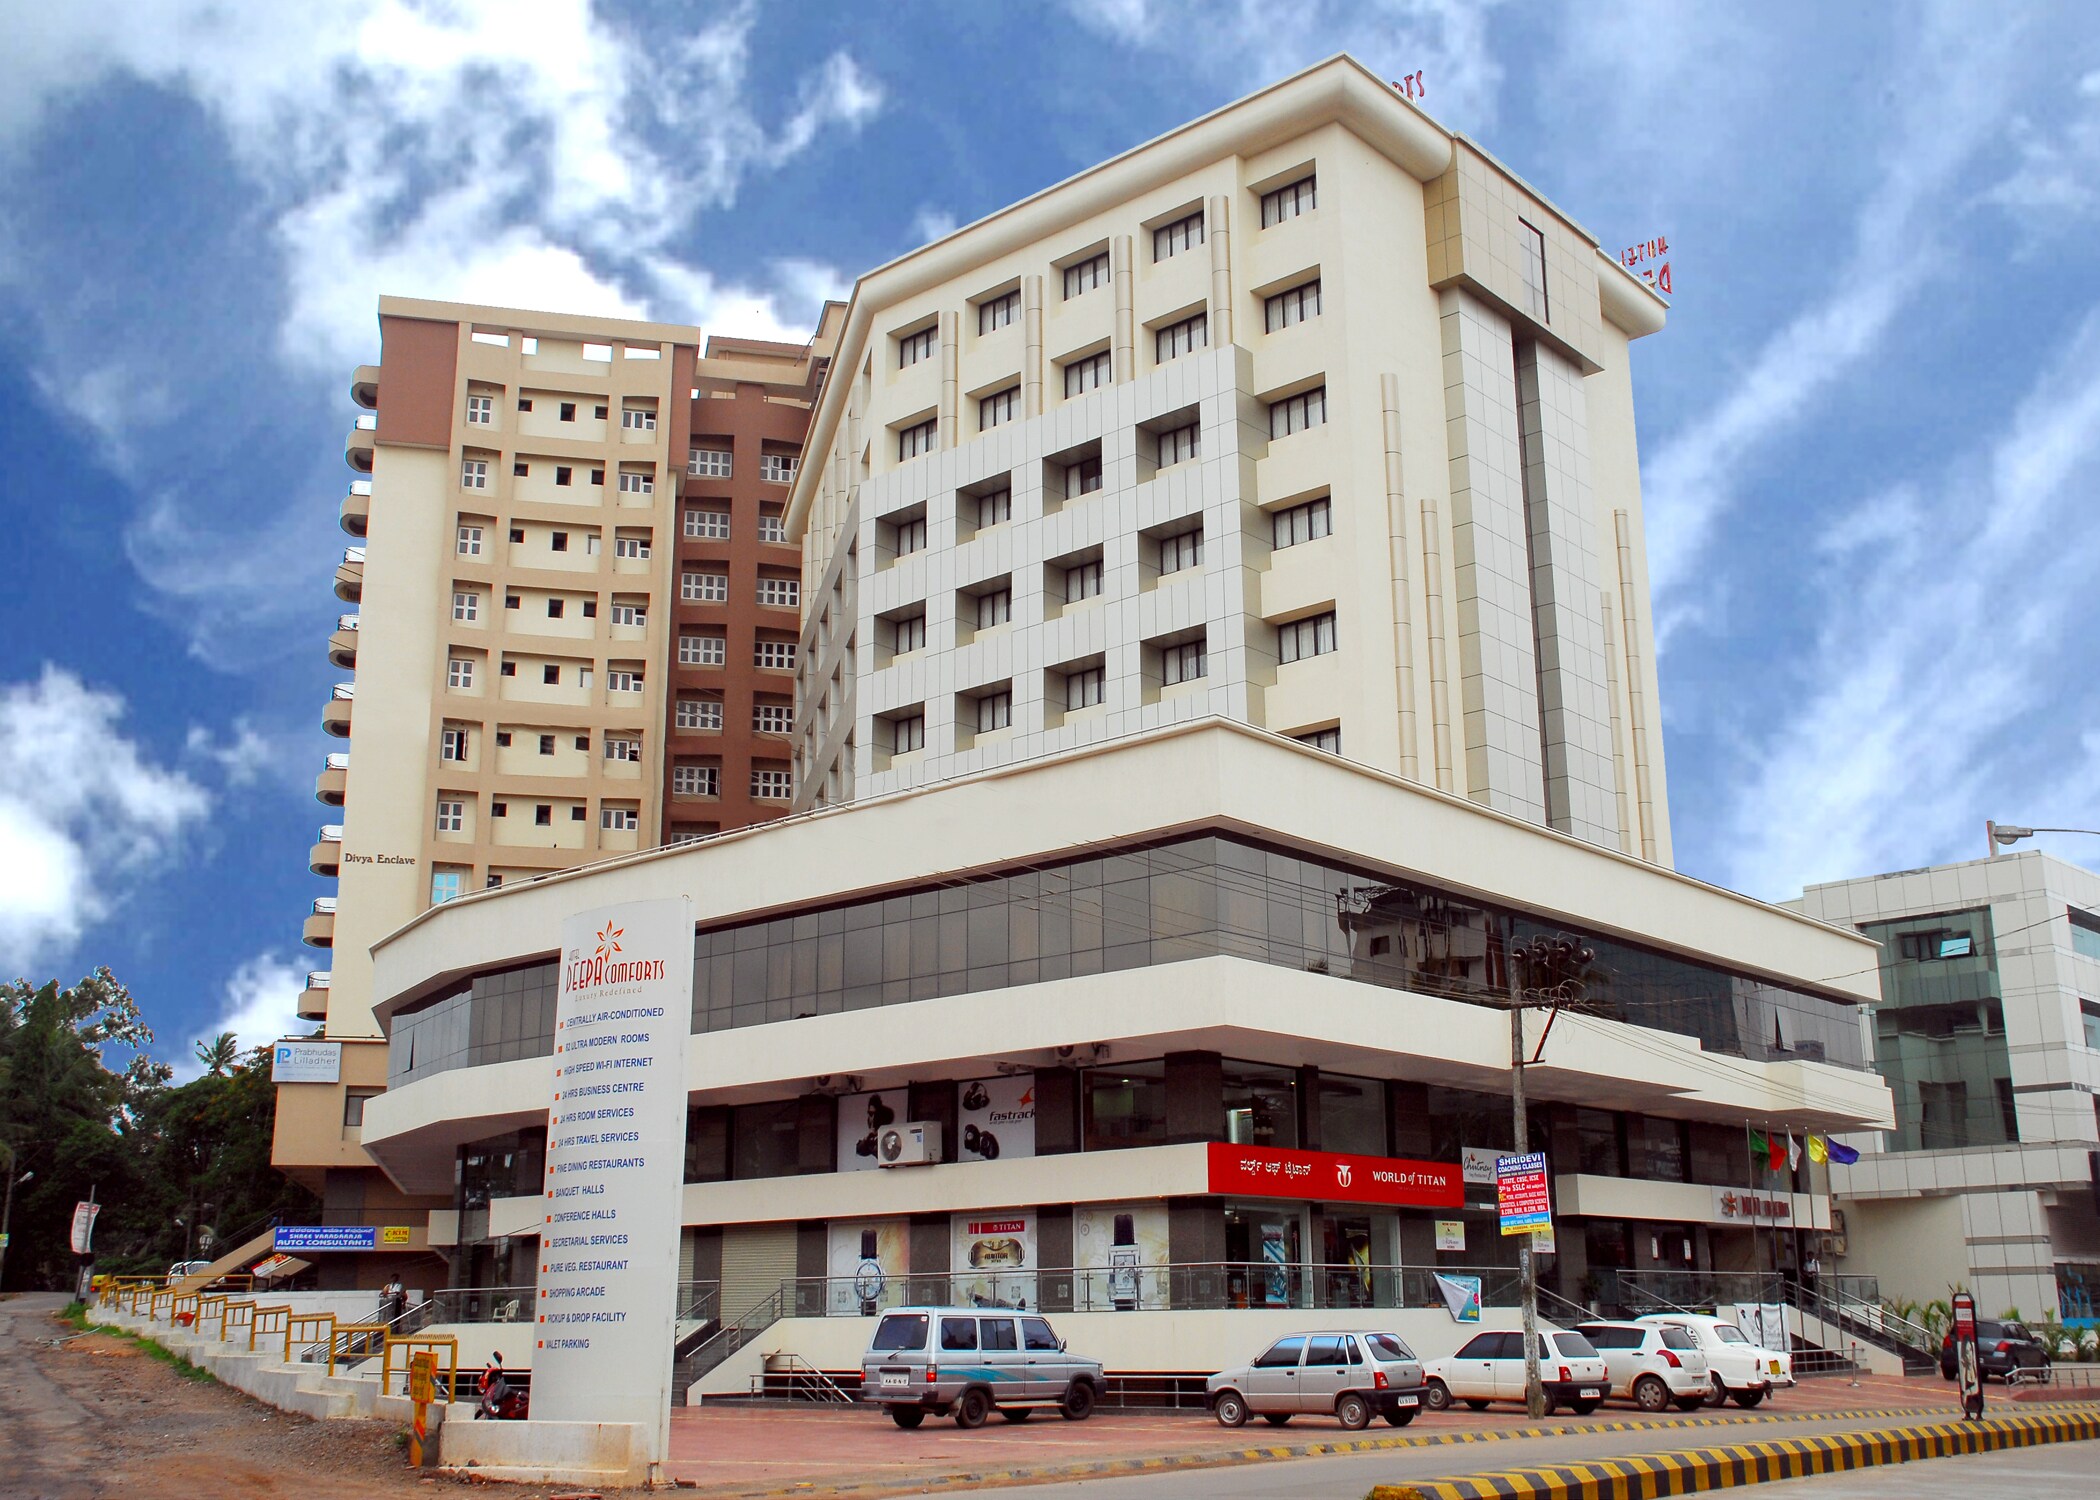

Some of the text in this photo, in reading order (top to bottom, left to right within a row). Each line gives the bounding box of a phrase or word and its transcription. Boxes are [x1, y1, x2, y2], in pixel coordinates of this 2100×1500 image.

[345, 852, 416, 865] Divya Enclave
[565, 956, 665, 995] DEEPA COMFORTS
[575, 986, 642, 1003] Luxury Redefined
[566, 1007, 665, 1028] CENTRALLY AIR-CONDITIONED
[571, 1039, 588, 1051] ULTRA
[588, 1035, 618, 1048] MODERN
[620, 1033, 650, 1043] ROOMS
[294, 1047, 337, 1057] Prabhudas
[294, 1057, 336, 1065] Lilladher
[564, 1057, 654, 1076] HIGH SPEED WI-FI INTERNET
[567, 1088, 578, 1099] HRS
[578, 1084, 611, 1097] BUSINESS
[612, 1082, 645, 1093] CENTRE
[566, 1112, 576, 1123] HRS
[577, 1110, 596, 1121] ROOM
[597, 1107, 635, 1119] SERVICES
[990, 1109, 1035, 1122] fastrack
[564, 1136, 575, 1147] HRS
[576, 1134, 599, 1145] TRAVEL
[600, 1131, 639, 1143] SERVICES
[556, 1157, 645, 1174] FINE DINING RESTAURANTS
[1498, 1161, 1542, 1173] COACHING CLASSES
[1499, 1154, 1541, 1166] SHRIDEVI
[1372, 1170, 1446, 1186] WORLD of TITAN
[555, 1184, 605, 1198] BANQUET HALLS
[1512, 1183, 1526, 1192] SSLC
[554, 1209, 616, 1223] CONFERENCE HALLS
[998, 1222, 1021, 1231] TITAN
[551, 1234, 629, 1248] SECRETARIAL SERVICES
[549, 1259, 629, 1273] PURE VEG. RESTAURANT
[549, 1286, 606, 1299] SHOPPING ARCADE
[547, 1311, 627, 1324] PICKUP & DROP FACILITY
[546, 1338, 590, 1349] VALET PARKING
